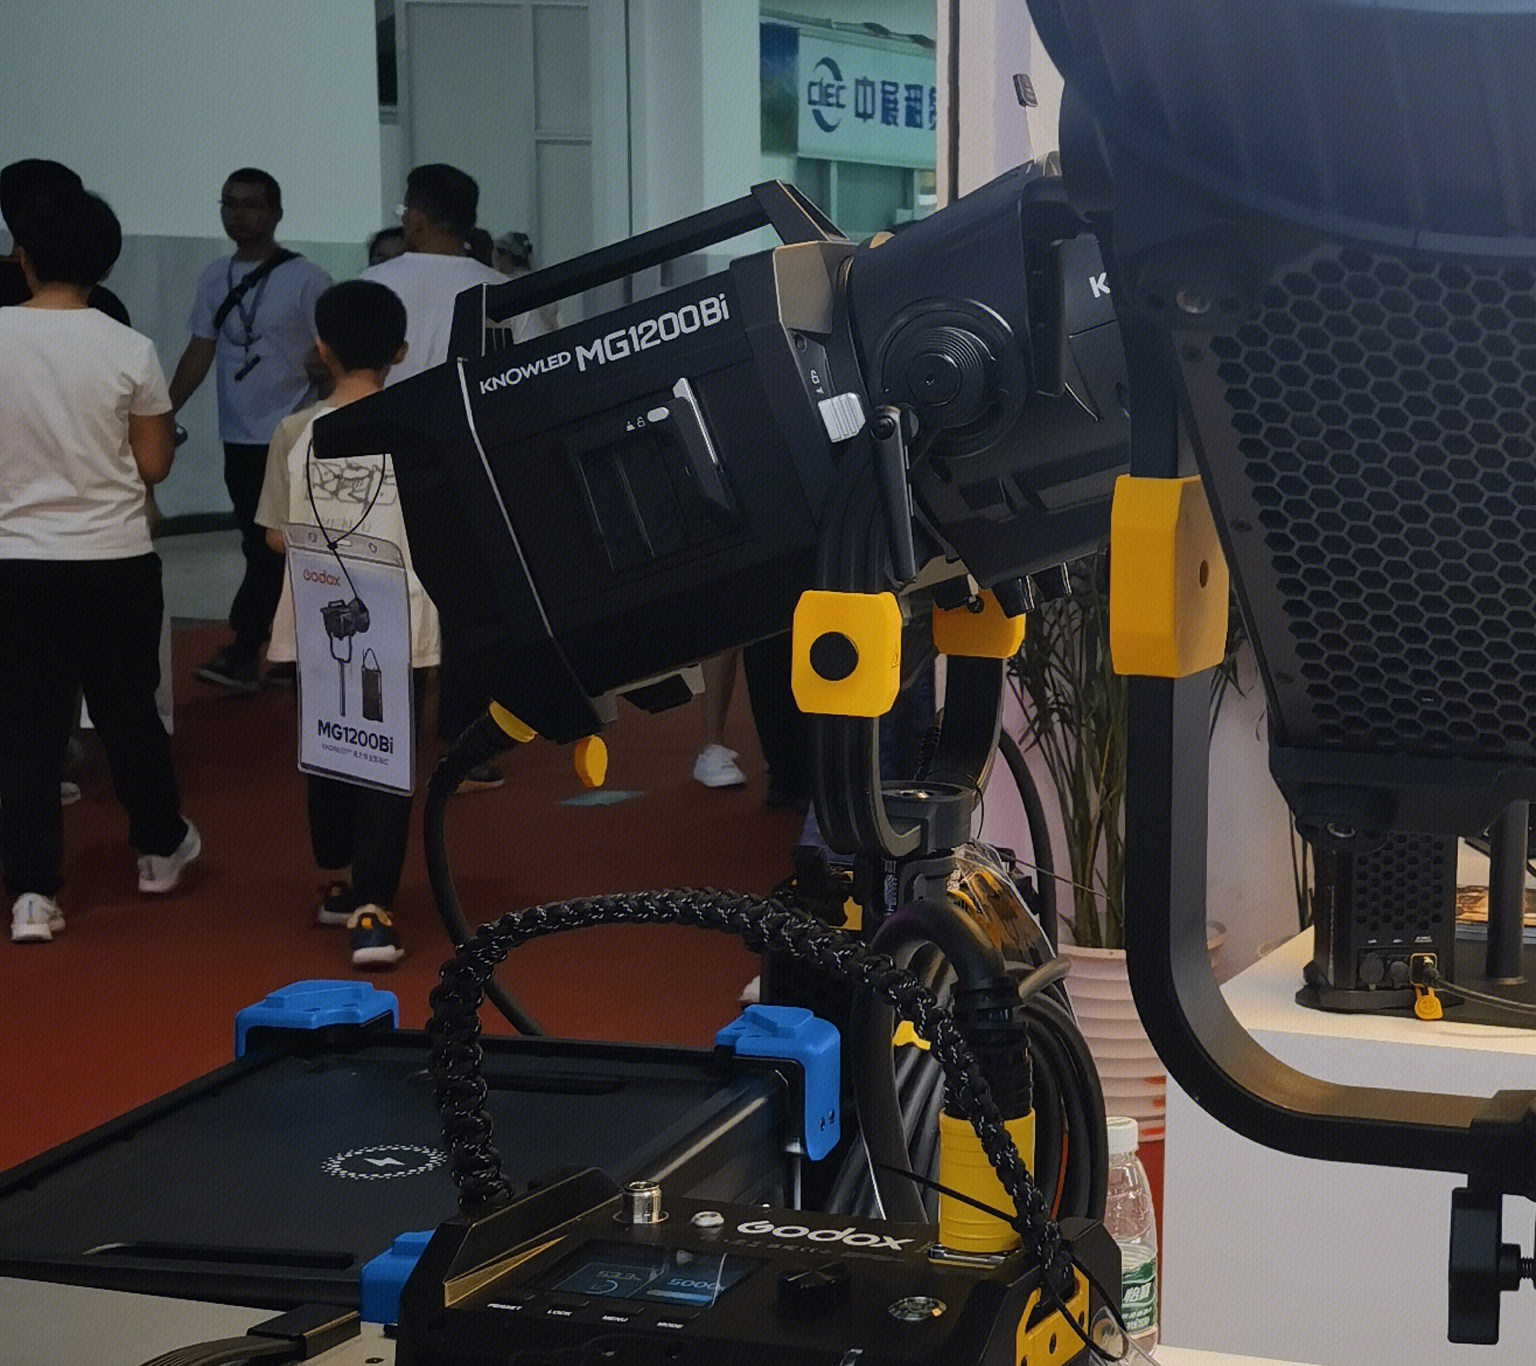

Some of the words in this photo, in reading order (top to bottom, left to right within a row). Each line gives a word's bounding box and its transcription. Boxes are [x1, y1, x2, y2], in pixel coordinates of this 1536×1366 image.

[479, 351, 572, 395] KNOWLED
[574, 292, 730, 372] MG1200Bi
[317, 718, 395, 755] MG1200Bi
[736, 1219, 915, 1252] Godox
